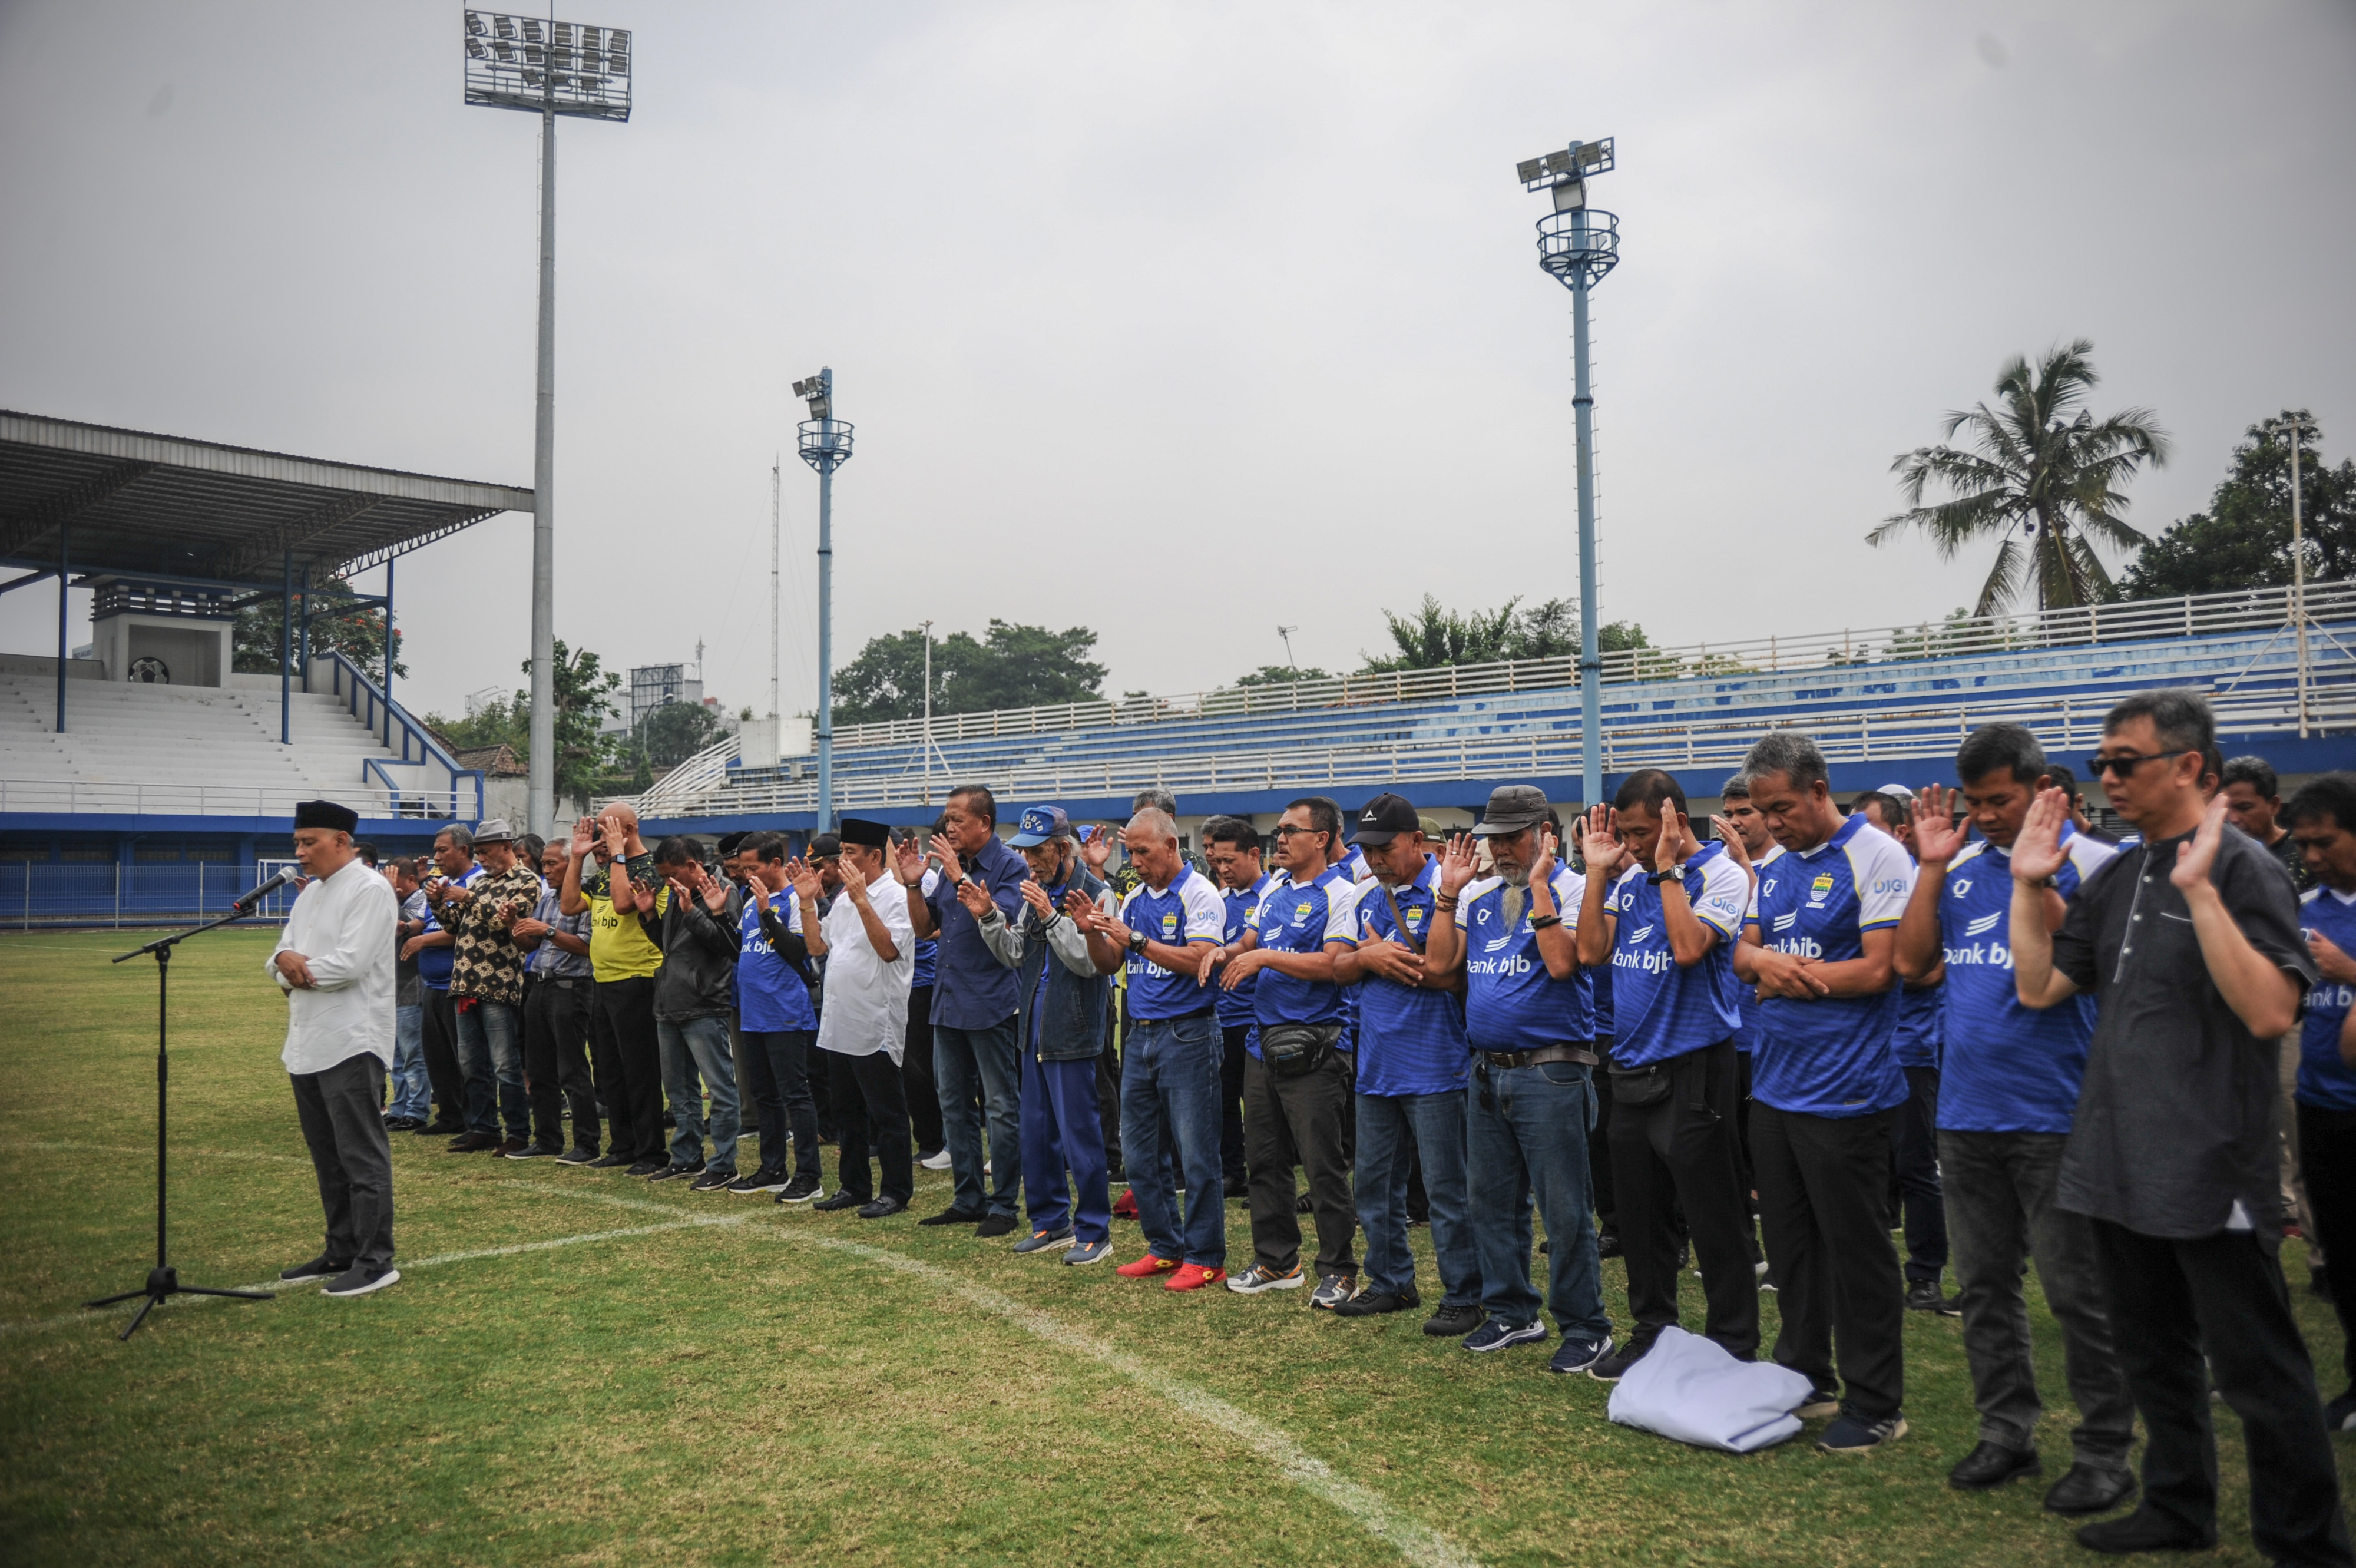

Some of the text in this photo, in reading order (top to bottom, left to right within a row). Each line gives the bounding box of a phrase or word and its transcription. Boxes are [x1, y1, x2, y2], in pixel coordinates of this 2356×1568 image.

[1874, 879, 1907, 894] DIGI
[1712, 896, 1740, 917] DIGI
[601, 916, 618, 929] bjb
[1197, 911, 1219, 923] DIGI
[1988, 942, 2014, 970] bj
[1127, 959, 1144, 975] bank
[1498, 954, 1531, 977] bjb
[2304, 986, 2332, 1007] ank
